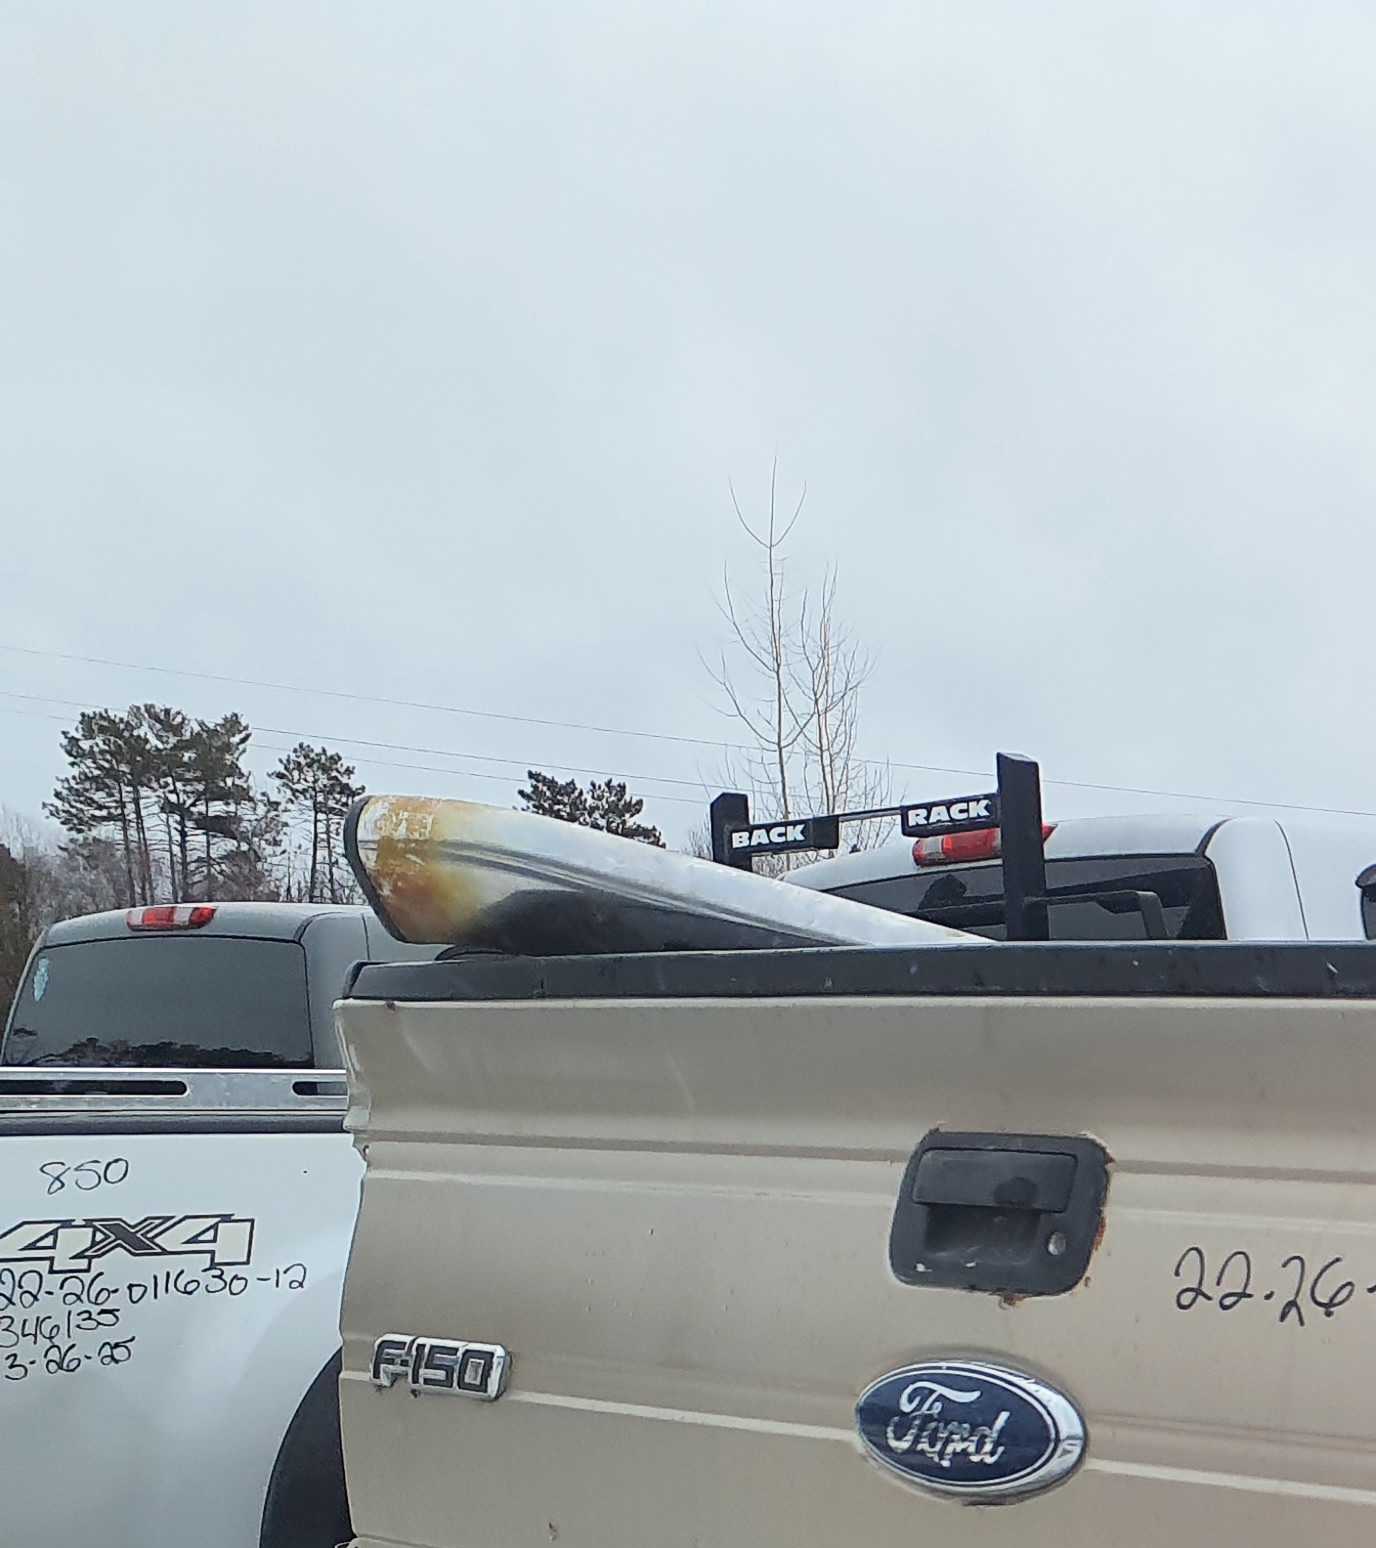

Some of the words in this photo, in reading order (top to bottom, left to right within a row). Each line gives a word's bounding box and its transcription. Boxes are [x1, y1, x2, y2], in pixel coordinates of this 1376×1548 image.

[731, 823, 806, 849] BACK
[907, 799, 990, 827] RACK
[40, 1157, 129, 1195] 850
[0, 1213, 255, 1274] 4X4
[5, 1336, 135, 1380] 3-26-25
[886, 1381, 1011, 1467] Ford
